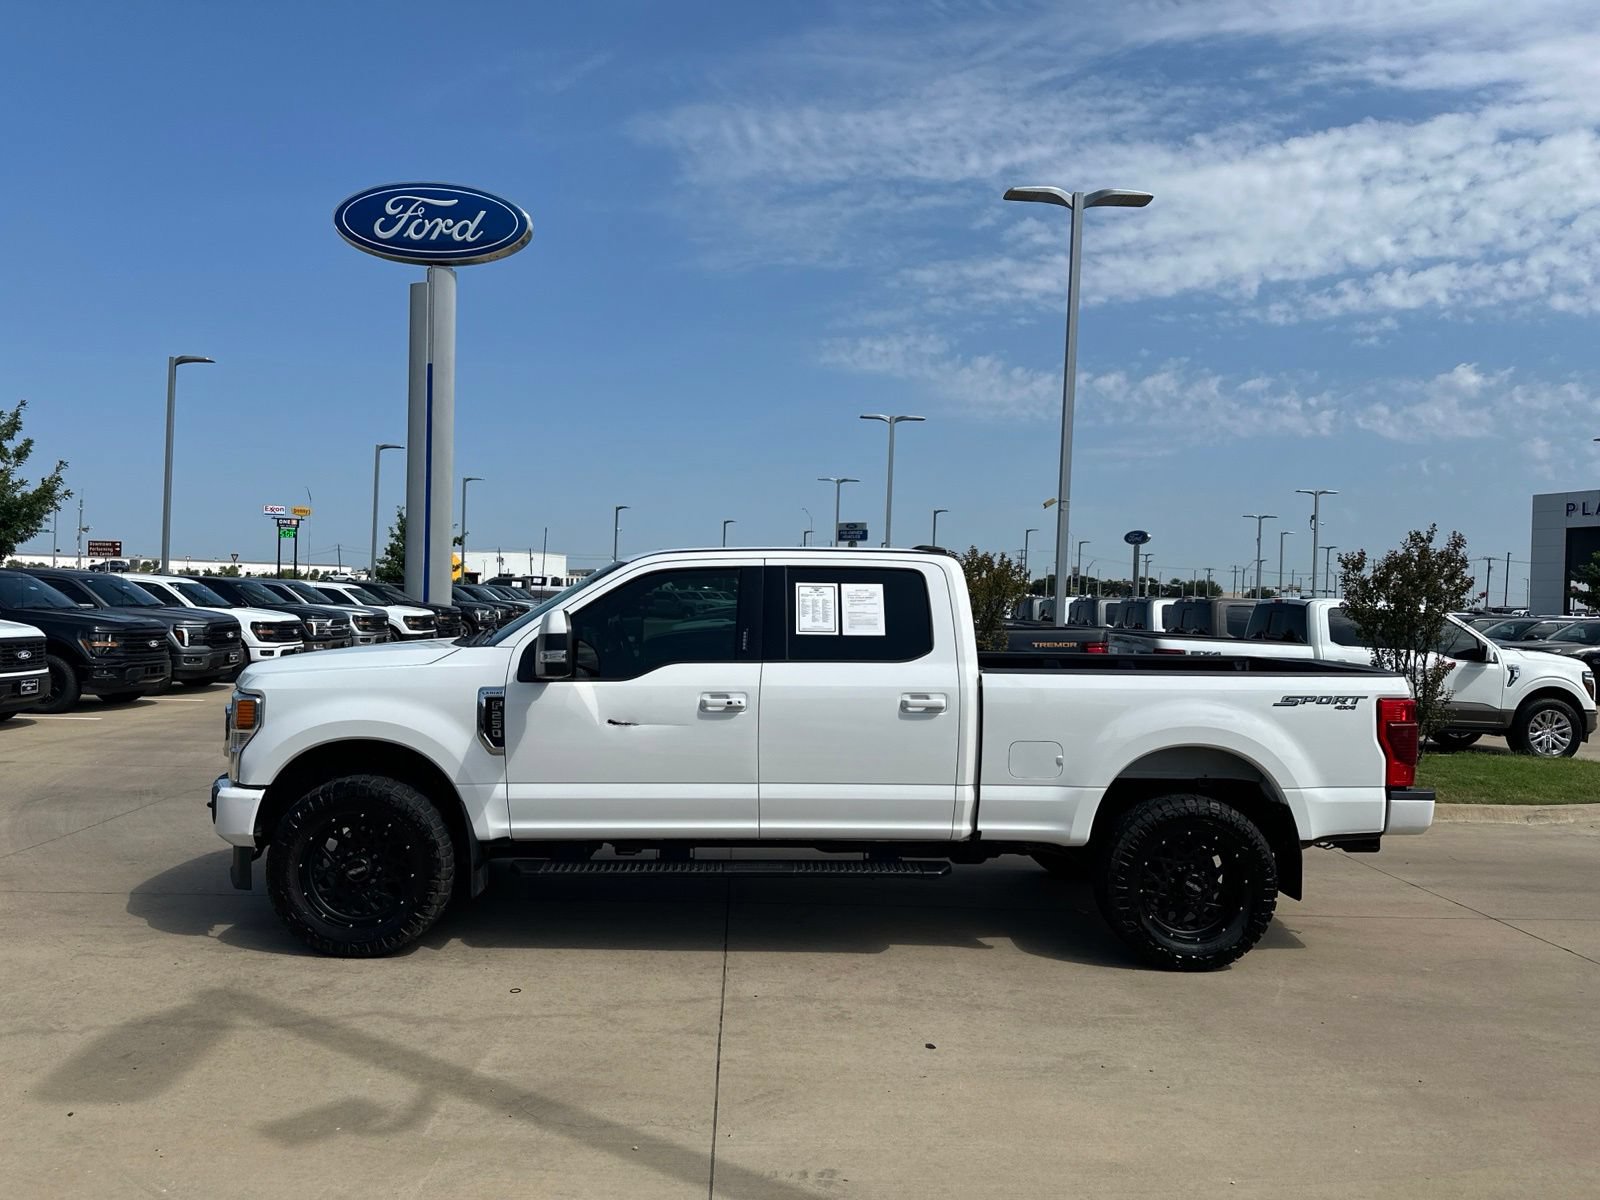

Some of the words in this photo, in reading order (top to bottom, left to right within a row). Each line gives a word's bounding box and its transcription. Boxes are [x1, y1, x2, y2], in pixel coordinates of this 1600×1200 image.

[373, 195, 487, 243] Ford
[264, 505, 285, 513] Exxon
[1272, 695, 1369, 707] SPORT
